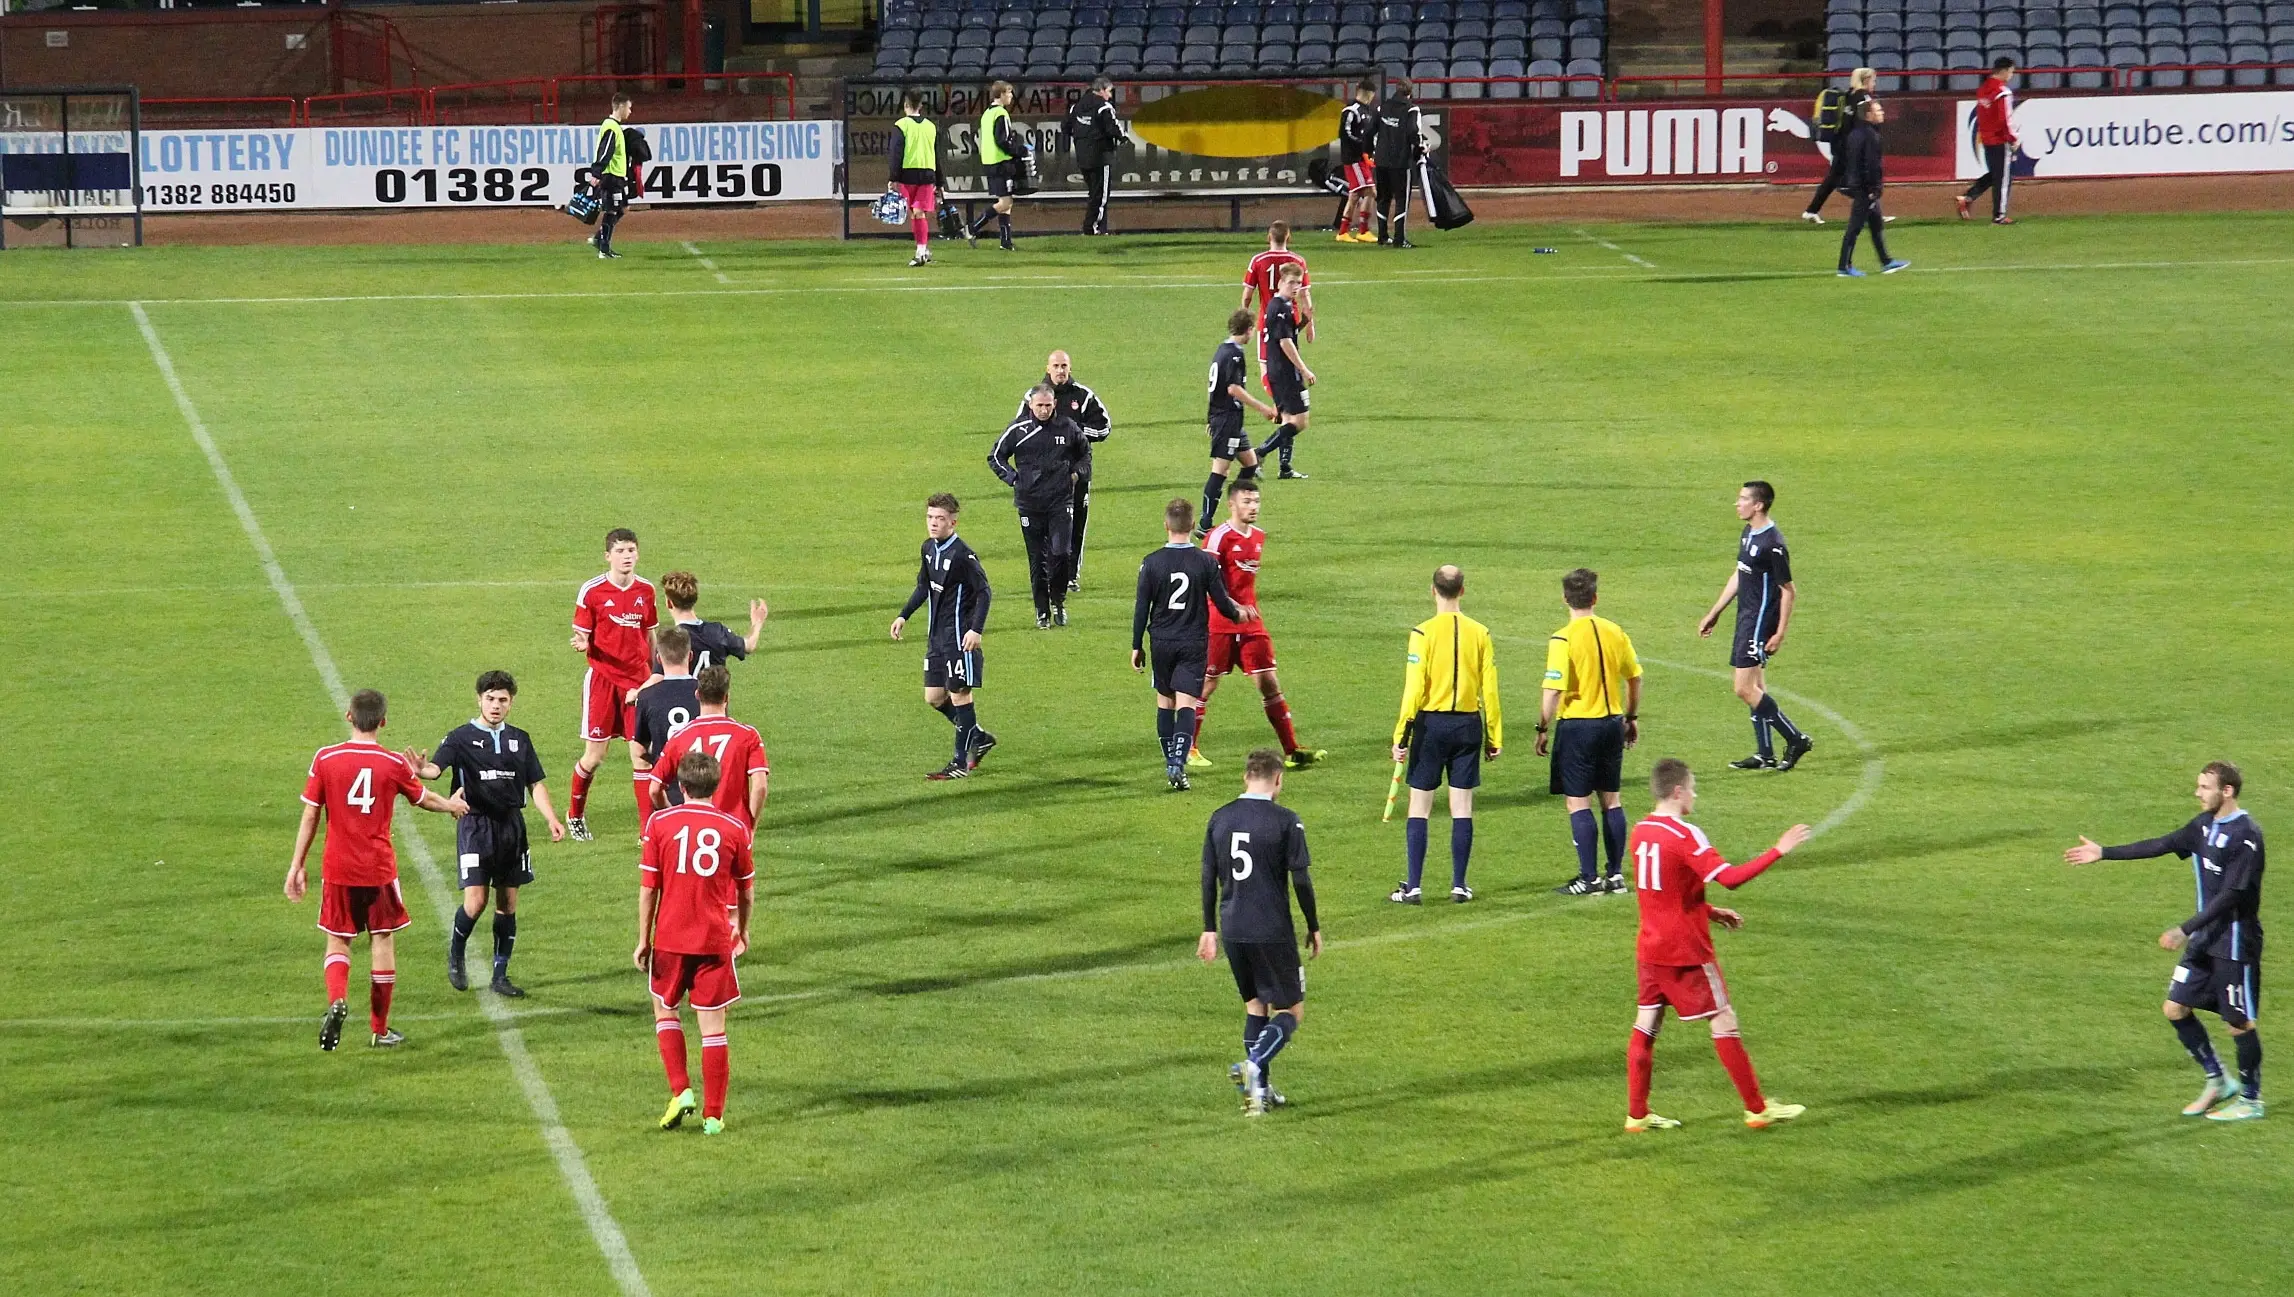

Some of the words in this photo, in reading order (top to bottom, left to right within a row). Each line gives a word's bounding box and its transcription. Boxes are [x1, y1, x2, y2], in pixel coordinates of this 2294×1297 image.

[140, 134, 295, 172] LOTTERY
[325, 128, 422, 166] DUNDEE
[433, 129, 460, 165] FC
[469, 127, 600, 165] HOSPITALI
[658, 123, 820, 162] ADVERTISING
[1560, 108, 1763, 176] PUMA
[2045, 114, 2294, 154] youtube.com/s
[211, 183, 295, 204] 884450
[375, 168, 549, 203] 01382
[574, 163, 781, 199] 84450
[1207, 362, 1219, 393] 9
[1055, 436, 1066, 445] TR
[1168, 572, 1190, 610] 2
[621, 612, 643, 621] Saltire
[1747, 639, 1759, 655] 3
[946, 659, 966, 678] 14
[667, 706, 690, 741] 8
[347, 768, 376, 814] 4
[673, 825, 722, 877] 18
[1230, 832, 1253, 881] 5
[1635, 841, 1663, 891] 11
[2225, 983, 2245, 1006] 11
